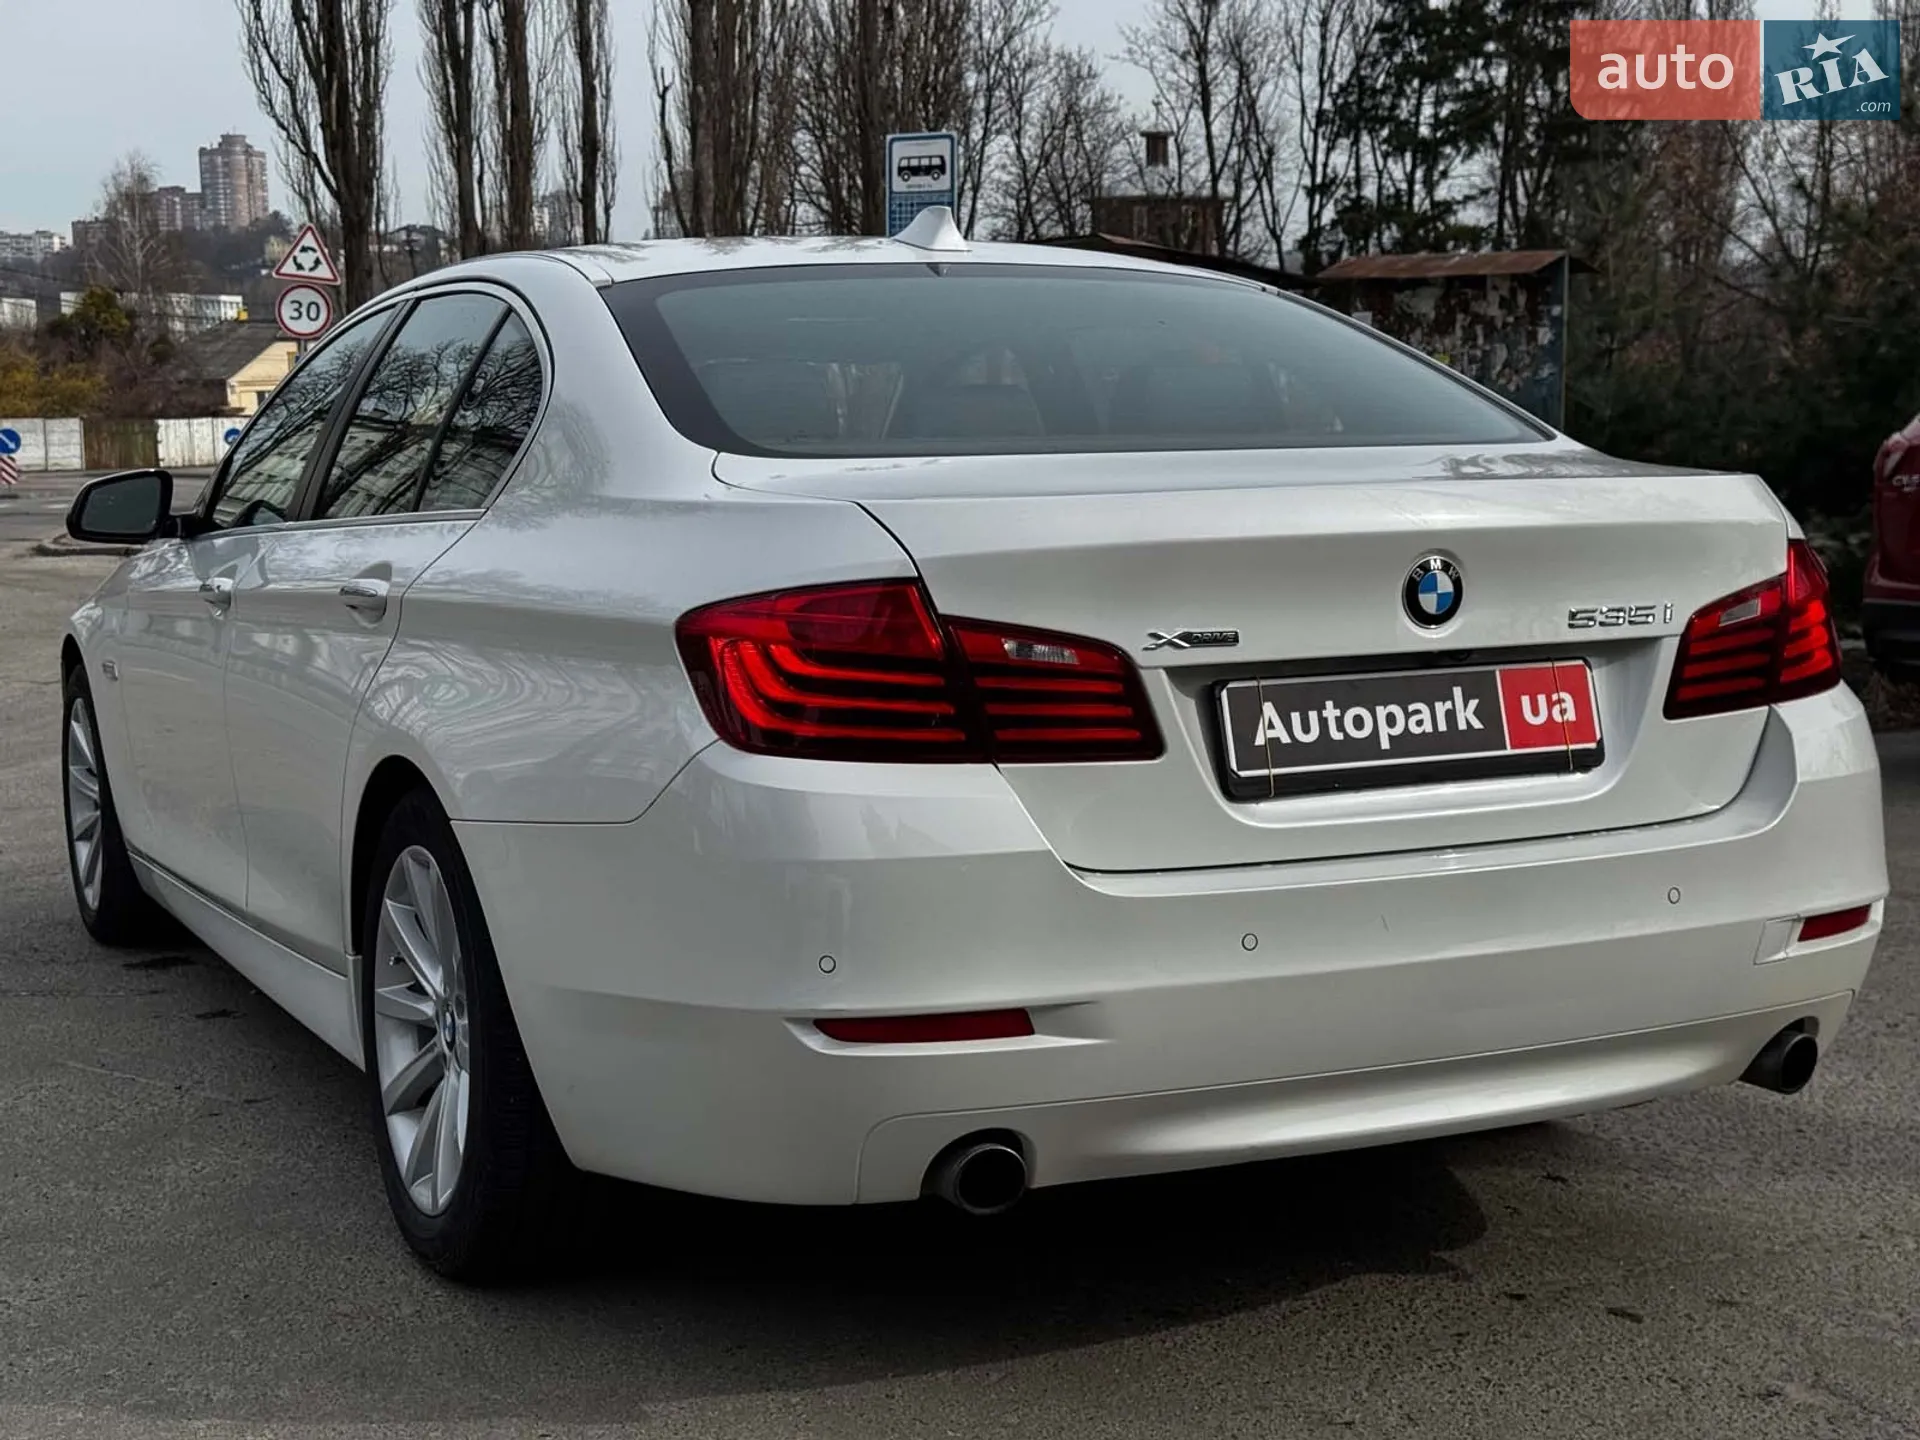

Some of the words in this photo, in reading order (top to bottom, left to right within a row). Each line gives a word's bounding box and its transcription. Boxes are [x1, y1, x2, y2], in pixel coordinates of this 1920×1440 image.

[289, 300, 320, 321] 30
[1411, 557, 1460, 581] BMW
[1567, 602, 1674, 629] 535i
[1253, 686, 1485, 750] Autopark
[1520, 690, 1577, 726] ua
